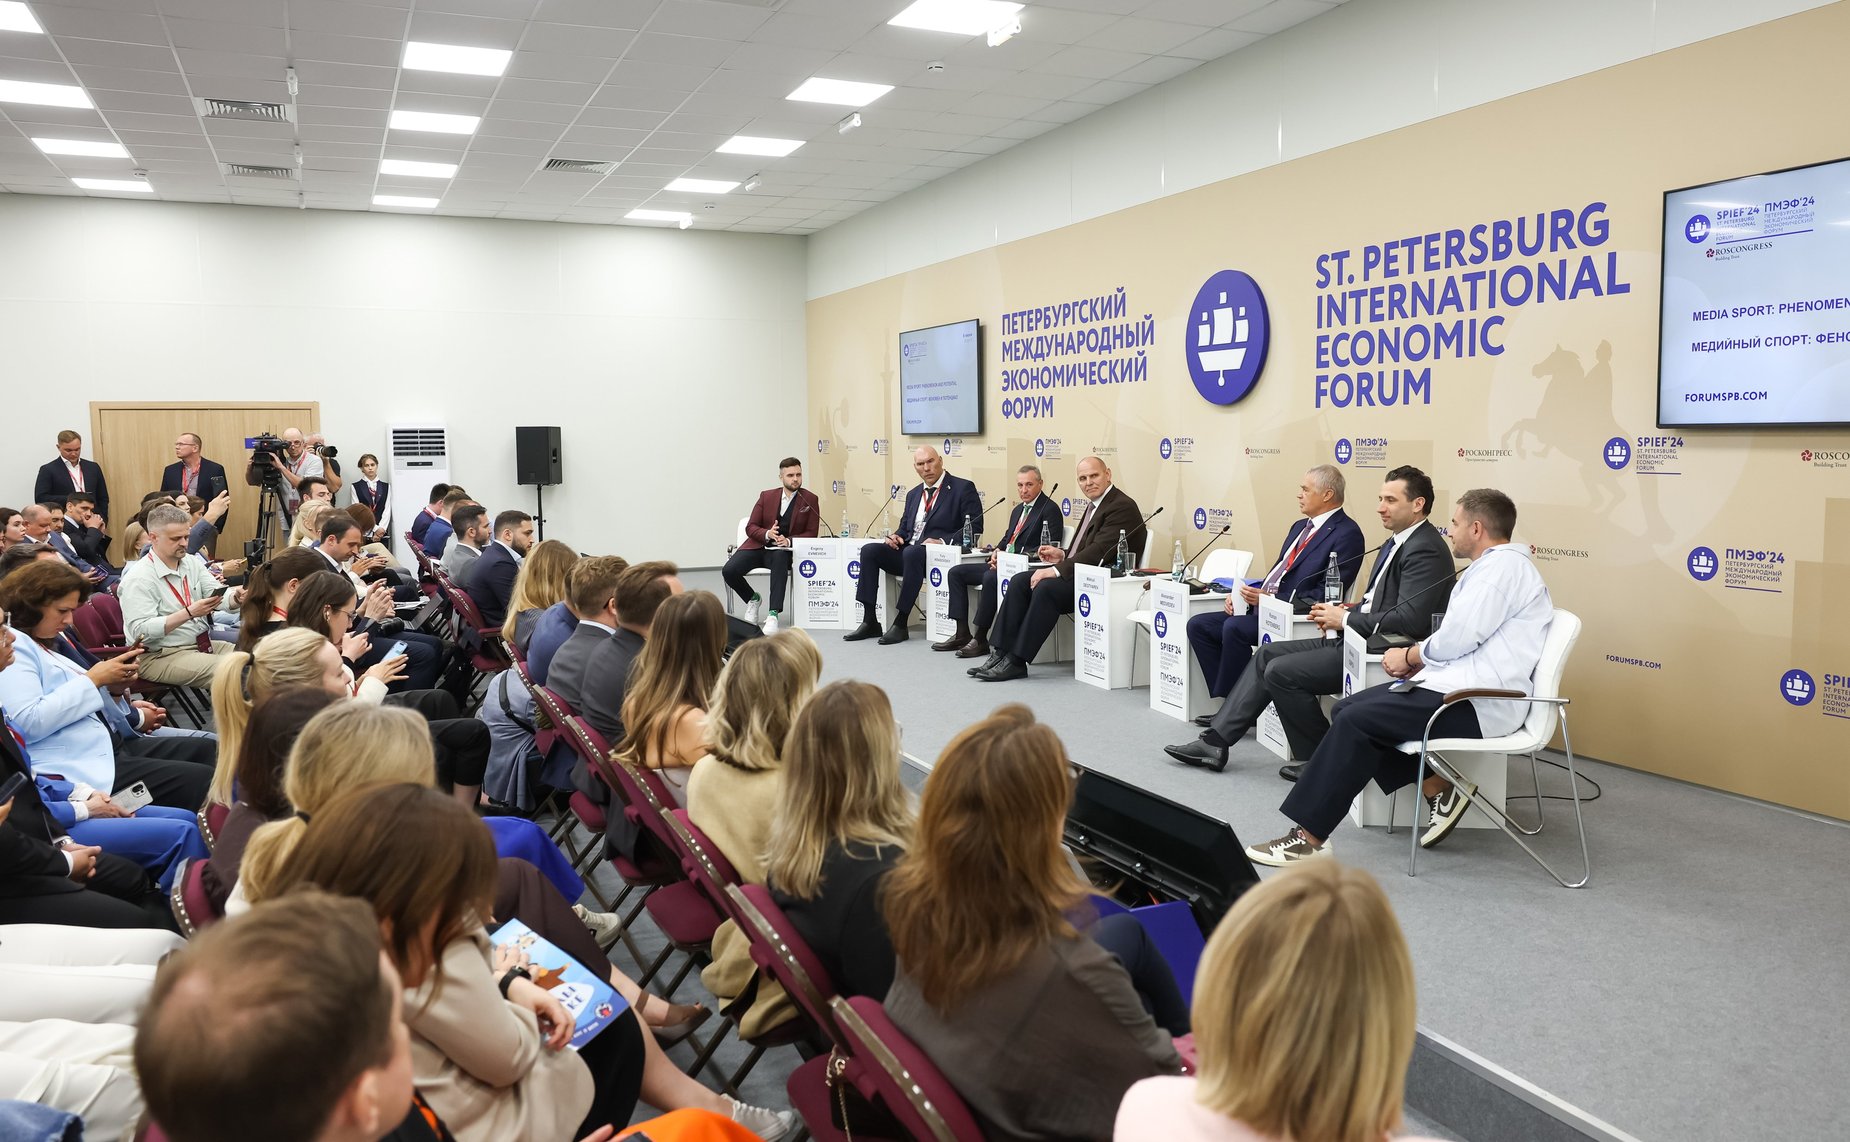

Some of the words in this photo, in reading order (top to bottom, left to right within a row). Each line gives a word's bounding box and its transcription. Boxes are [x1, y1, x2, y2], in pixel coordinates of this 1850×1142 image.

[1316, 250, 1354, 289] ST.
[1364, 202, 1610, 282] PETERSBURG
[1716, 242, 1772, 256] ROSCONGRESS
[1316, 252, 1630, 329] INTERNATIONAL
[1002, 286, 1126, 335] ПЕТЕРБУРГСКИЙ
[1692, 309, 1728, 321] MEDIA
[1732, 304, 1774, 318] SPORT:
[1002, 314, 1154, 362] МЕЖДУНАРОДНЫЙ
[1316, 316, 1505, 368] ECONOMIC
[1692, 336, 1760, 352] МЕДИЙНЫЙ
[1764, 334, 1811, 347] СПОРТ:
[1002, 350, 1147, 392] ЭКОНОМИЧЕСКИЙ
[1316, 368, 1431, 408] FORUM
[1685, 391, 1768, 402] FORUMSPB.COM
[1002, 396, 1054, 419] ФОРУМ
[1637, 436, 1684, 448] SPIEF'24
[1465, 449, 1512, 457] РОСКОНГРЕСС
[1814, 452, 1850, 460] ROSCO
[1536, 546, 1588, 558] ROSCONGRESS
[1726, 548, 1784, 564] ПМЭФ'24
[1725, 566, 1782, 576] МЕЖДУНАРОДНЫЙ
[1726, 560, 1774, 569] ПЕТЕРБУРГСКИЙ
[1725, 572, 1780, 582] ЭКОНОМИЧЕСКИЙ
[1606, 654, 1662, 670] FORUMSPB.COM
[1834, 688, 1850, 696] PETE
[1823, 705, 1846, 714] FORUM
